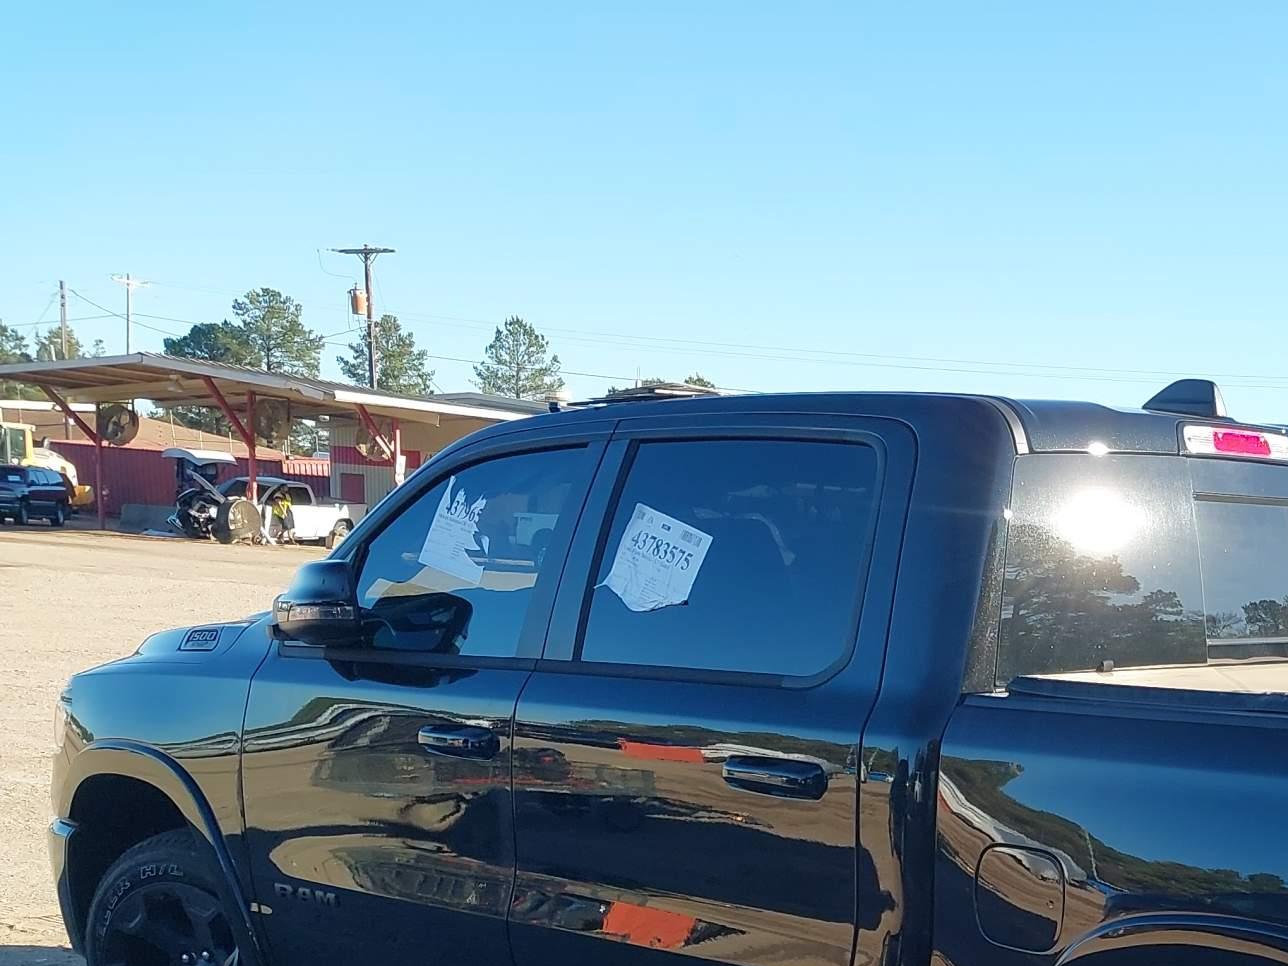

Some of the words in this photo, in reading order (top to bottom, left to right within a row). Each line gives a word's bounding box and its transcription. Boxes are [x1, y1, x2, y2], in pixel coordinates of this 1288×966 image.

[632, 530, 694, 571] 43783575
[189, 631, 217, 641] 1500
[274, 882, 339, 906] RAM
